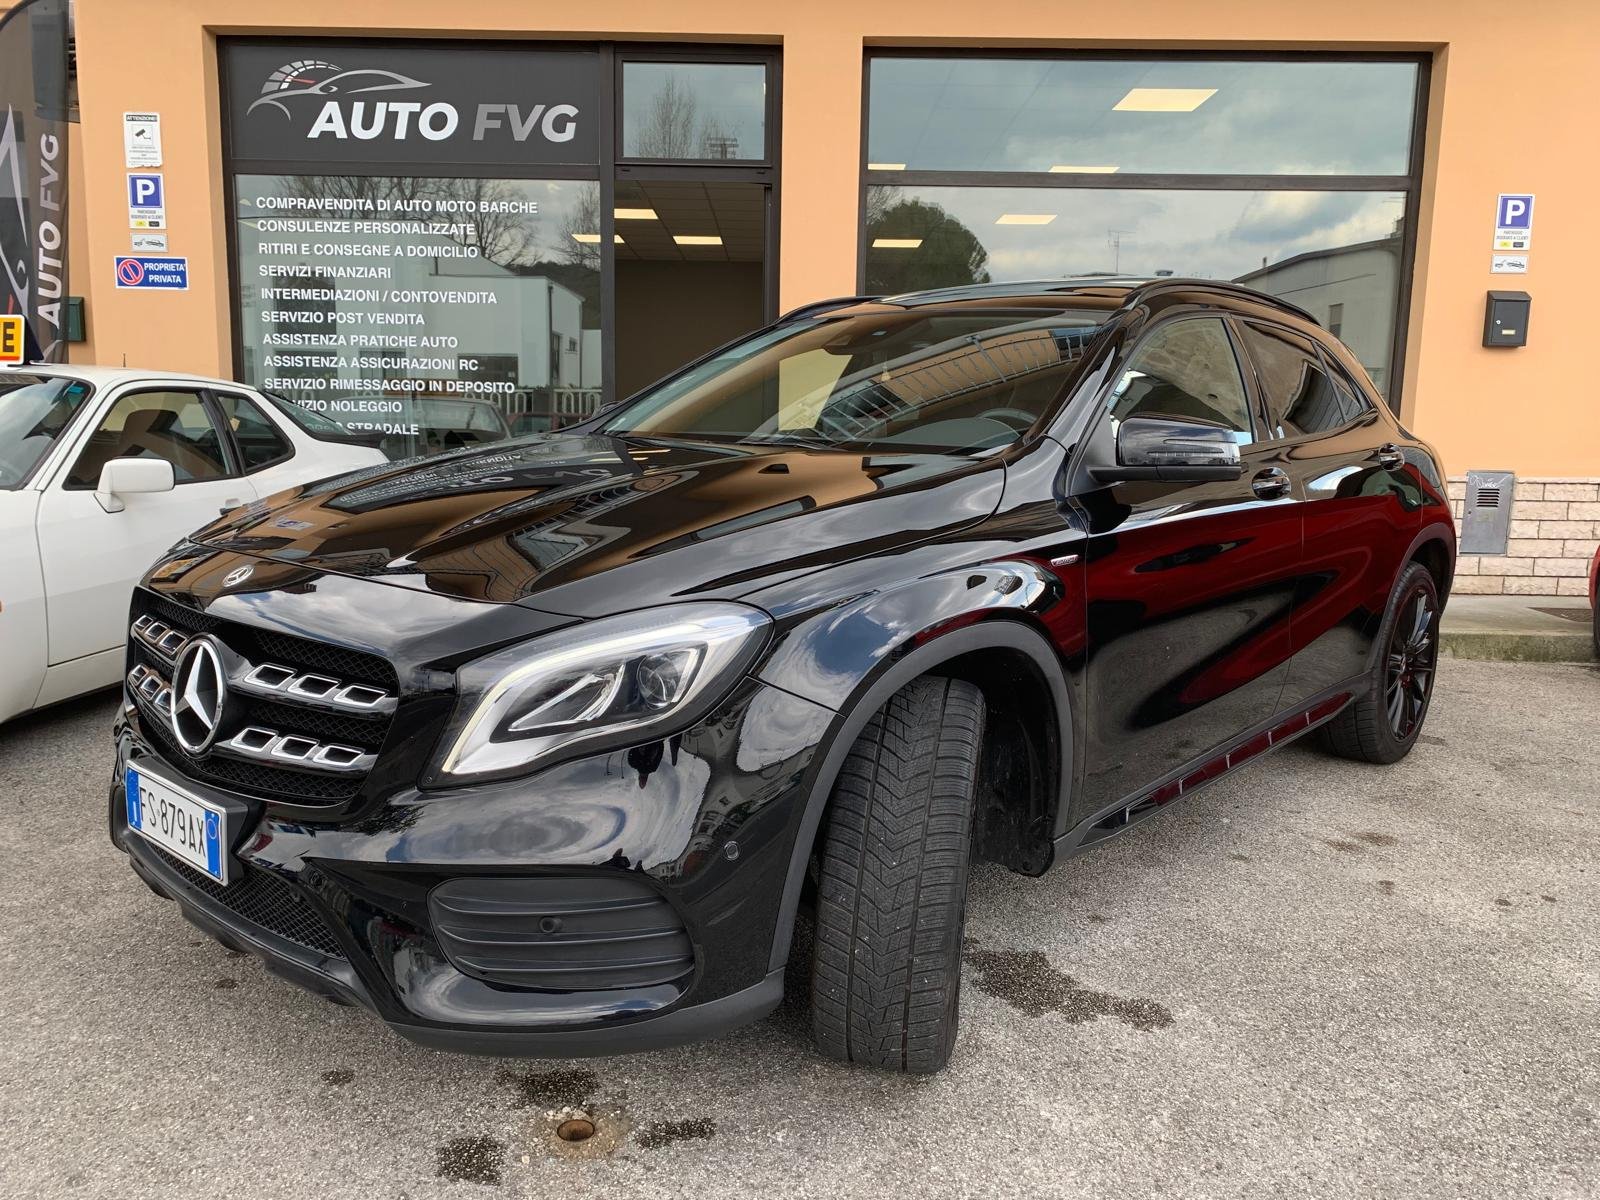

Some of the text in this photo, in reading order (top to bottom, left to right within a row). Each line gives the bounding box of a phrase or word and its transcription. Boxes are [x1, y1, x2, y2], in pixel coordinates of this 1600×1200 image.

[307, 101, 579, 142] AUTO FVG
[256, 197, 537, 214] COMPRAVENDITA DI AUTO MOTO BARCHE
[38, 133, 62, 330] AUTO FVG
[257, 220, 476, 235] CONSULENZE PERSONALIZZATE
[259, 243, 479, 258] RITIRI E CONSEGNE A DOMICILIO
[148, 274, 182, 284] PRIVATA
[260, 265, 390, 278] SERVIZI FINANZIARI
[262, 288, 496, 303] INTERMEDIAZIONI / CONTOVENDITA
[262, 311, 424, 324] SERVIZIO POST VENDITA
[263, 334, 457, 347] ASSISTENZA PRATICHE AUTO
[264, 356, 478, 370] ASSISTENZA ASSICURAZIONI RC
[264, 378, 515, 393] SERVIZIO RIMESSAGGIO IN DEPOSITO
[331, 401, 402, 412] NOLEGGIO
